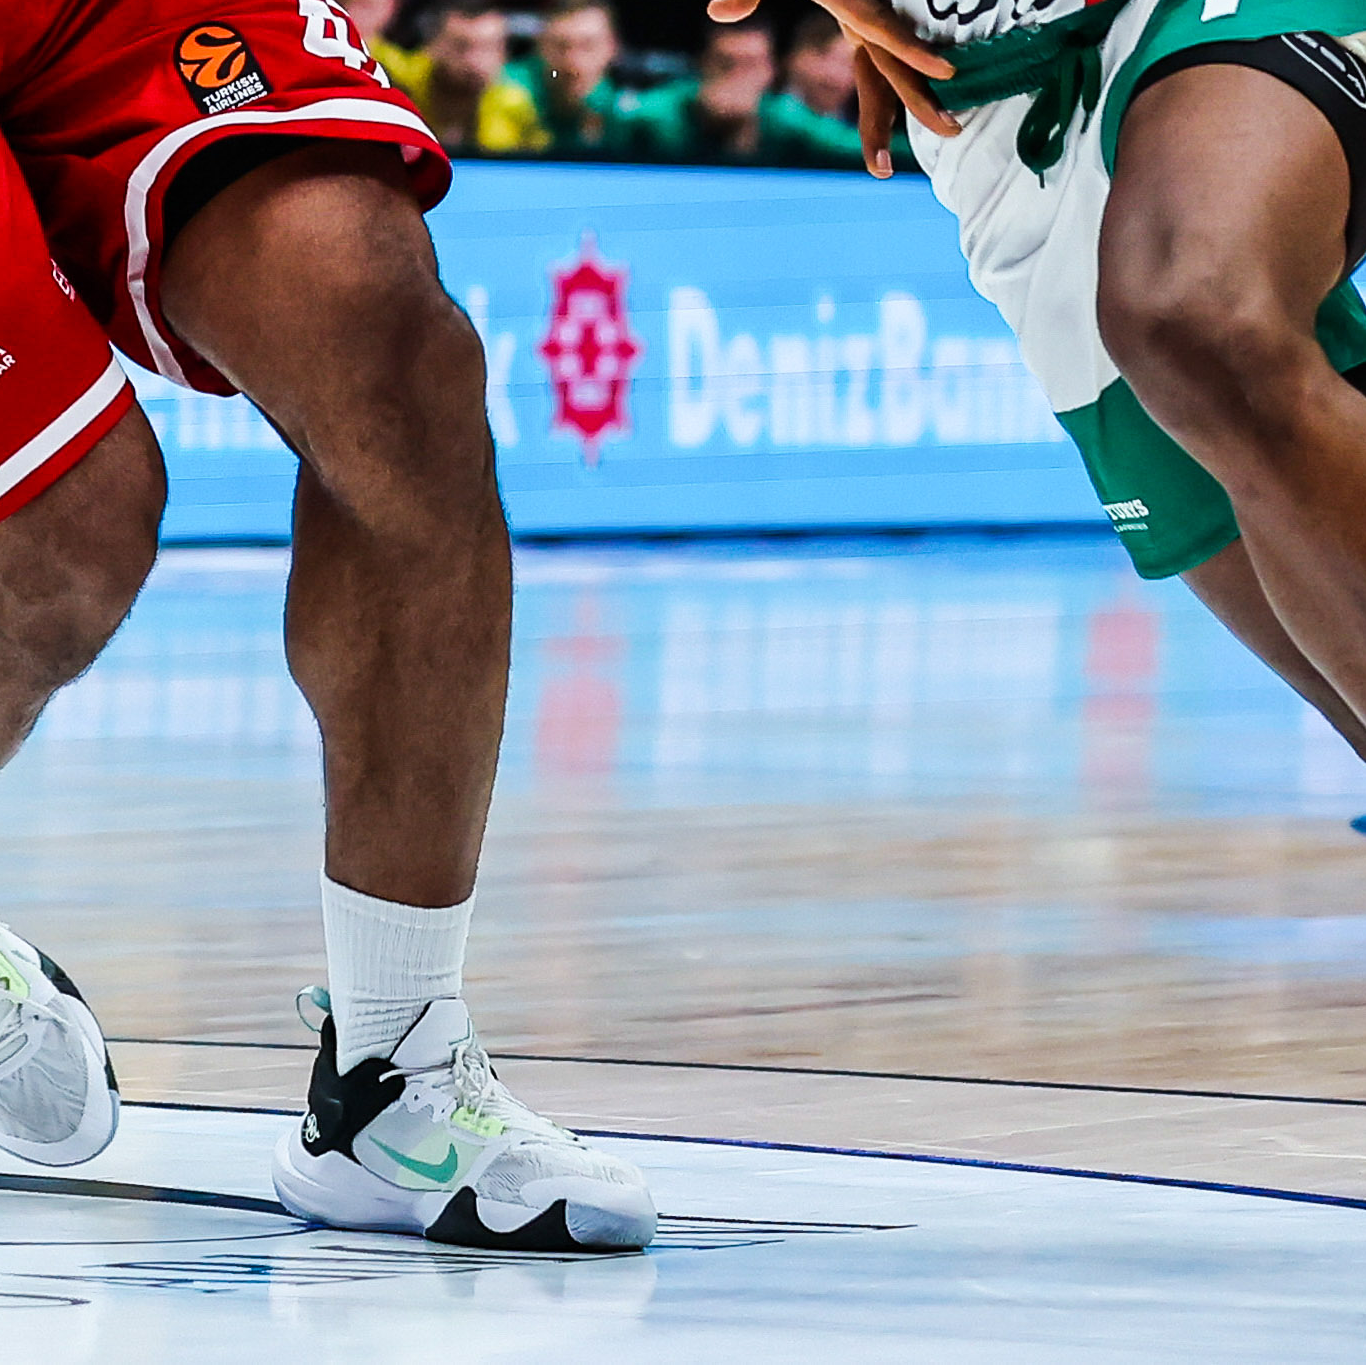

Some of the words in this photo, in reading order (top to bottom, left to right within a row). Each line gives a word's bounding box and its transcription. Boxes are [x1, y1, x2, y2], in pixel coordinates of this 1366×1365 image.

[202, 71, 260, 107] TURKISH
[208, 81, 265, 115] AIRLINES
[668, 285, 1067, 448] DenizBan
